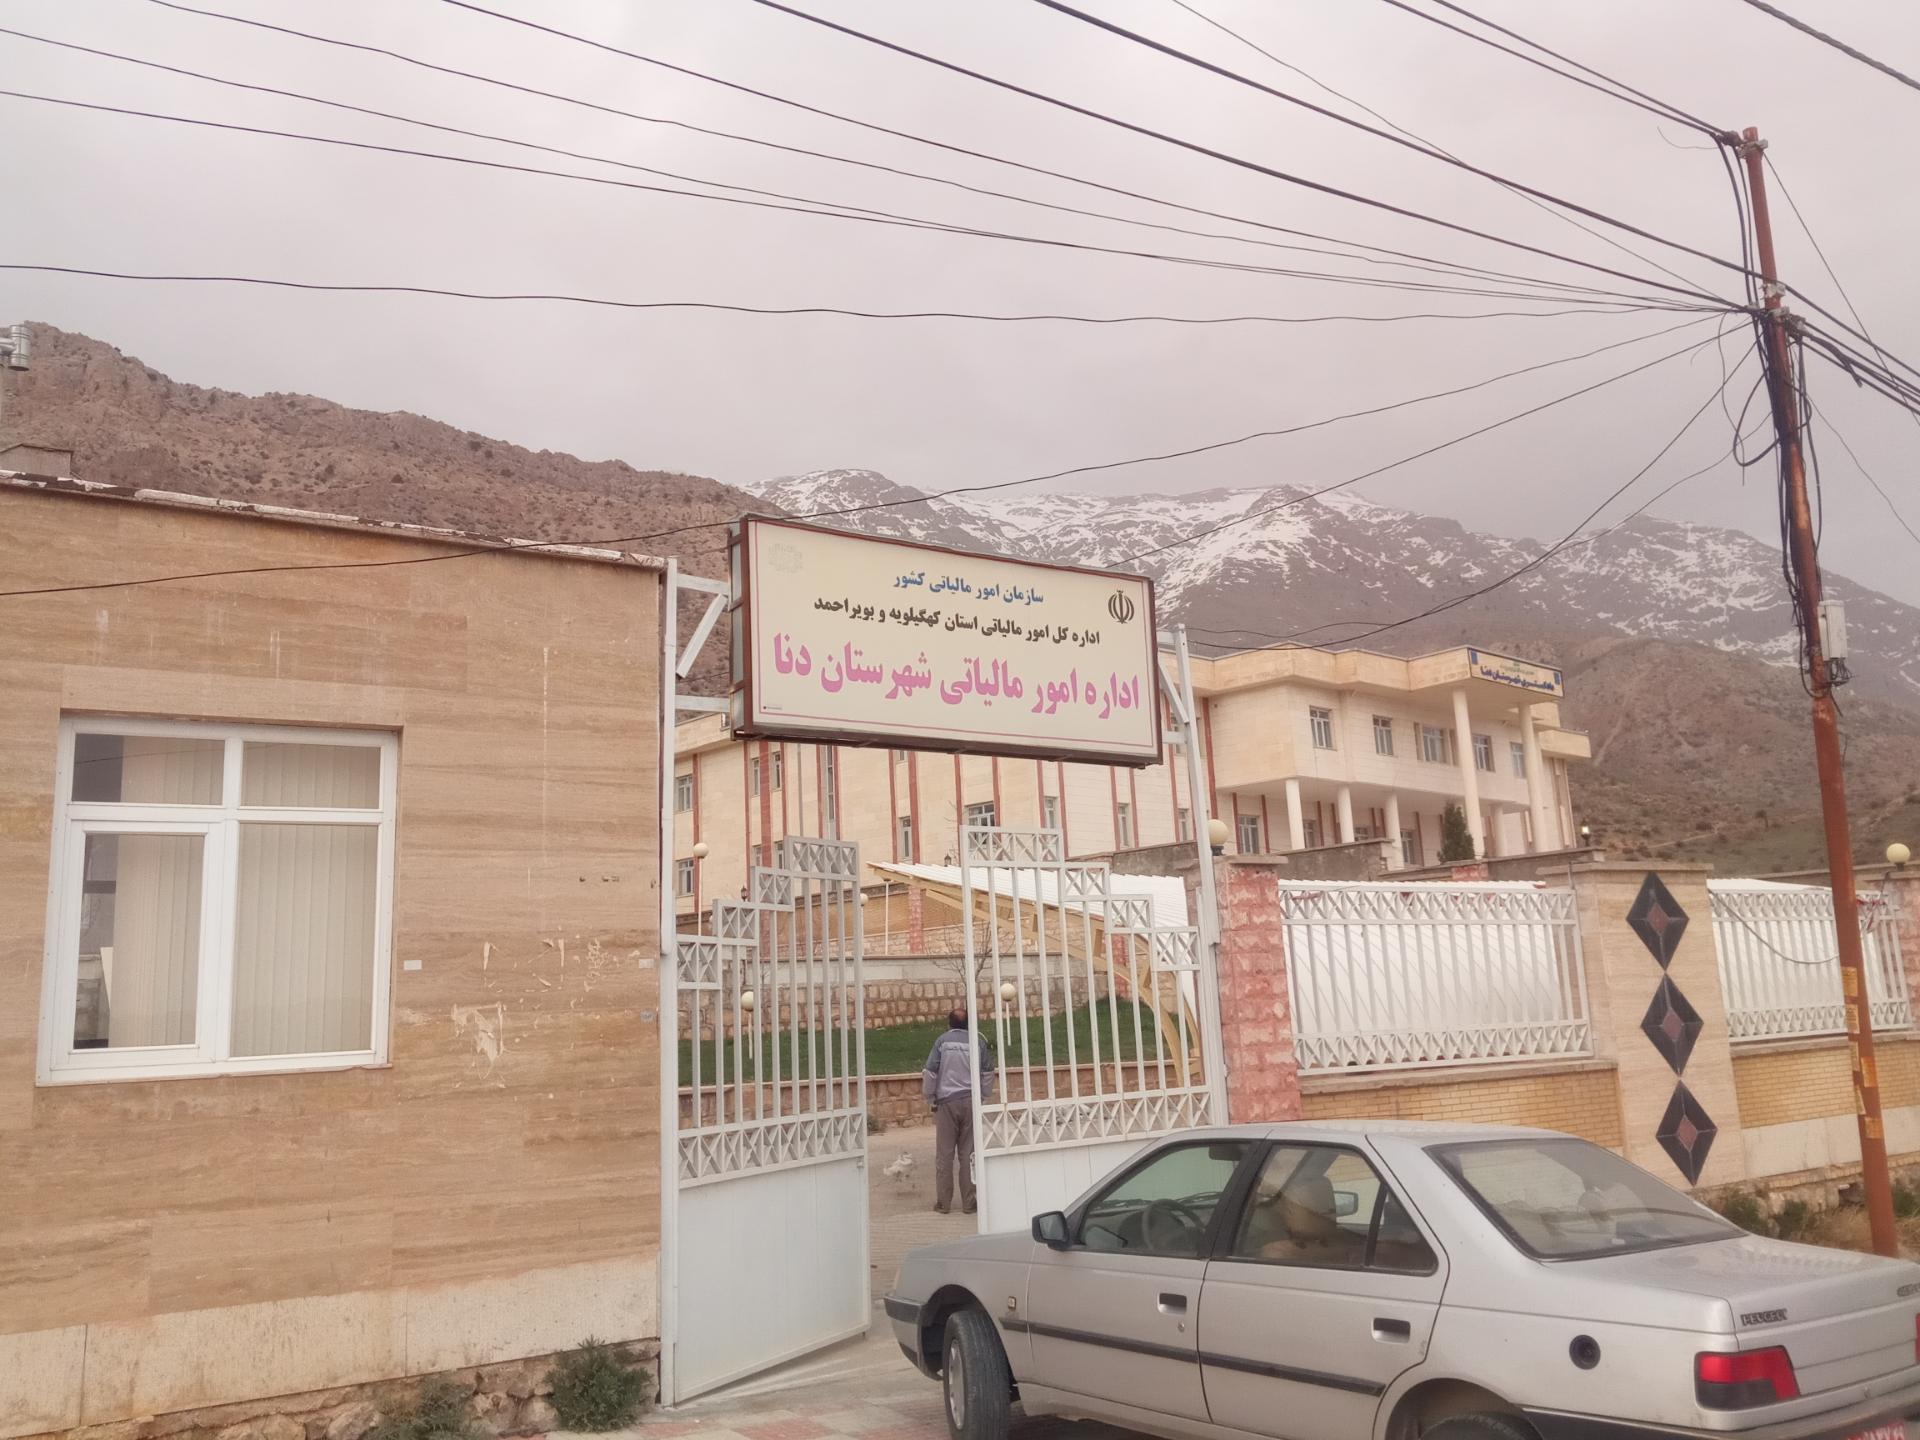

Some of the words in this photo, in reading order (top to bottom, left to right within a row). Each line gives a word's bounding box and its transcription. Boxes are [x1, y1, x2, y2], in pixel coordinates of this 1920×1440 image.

[893, 570, 925, 588] کشور
[929, 575, 972, 595] مالیاتی
[976, 583, 1000, 600] امور
[1003, 586, 1044, 605] سازمان
[878, 609, 886, 623] و
[889, 606, 941, 627] کهگیلویه
[944, 612, 978, 631] استان
[981, 618, 1022, 638] مالیاتی
[1025, 624, 1049, 642] امور
[1052, 626, 1069, 644] کل
[1072, 629, 1100, 647] اداره
[774, 632, 812, 676] دنا
[821, 640, 931, 699] شهرستان
[940, 656, 1023, 707] مالیاتی
[1031, 667, 1078, 714] امور
[1084, 671, 1139, 719] اداره
